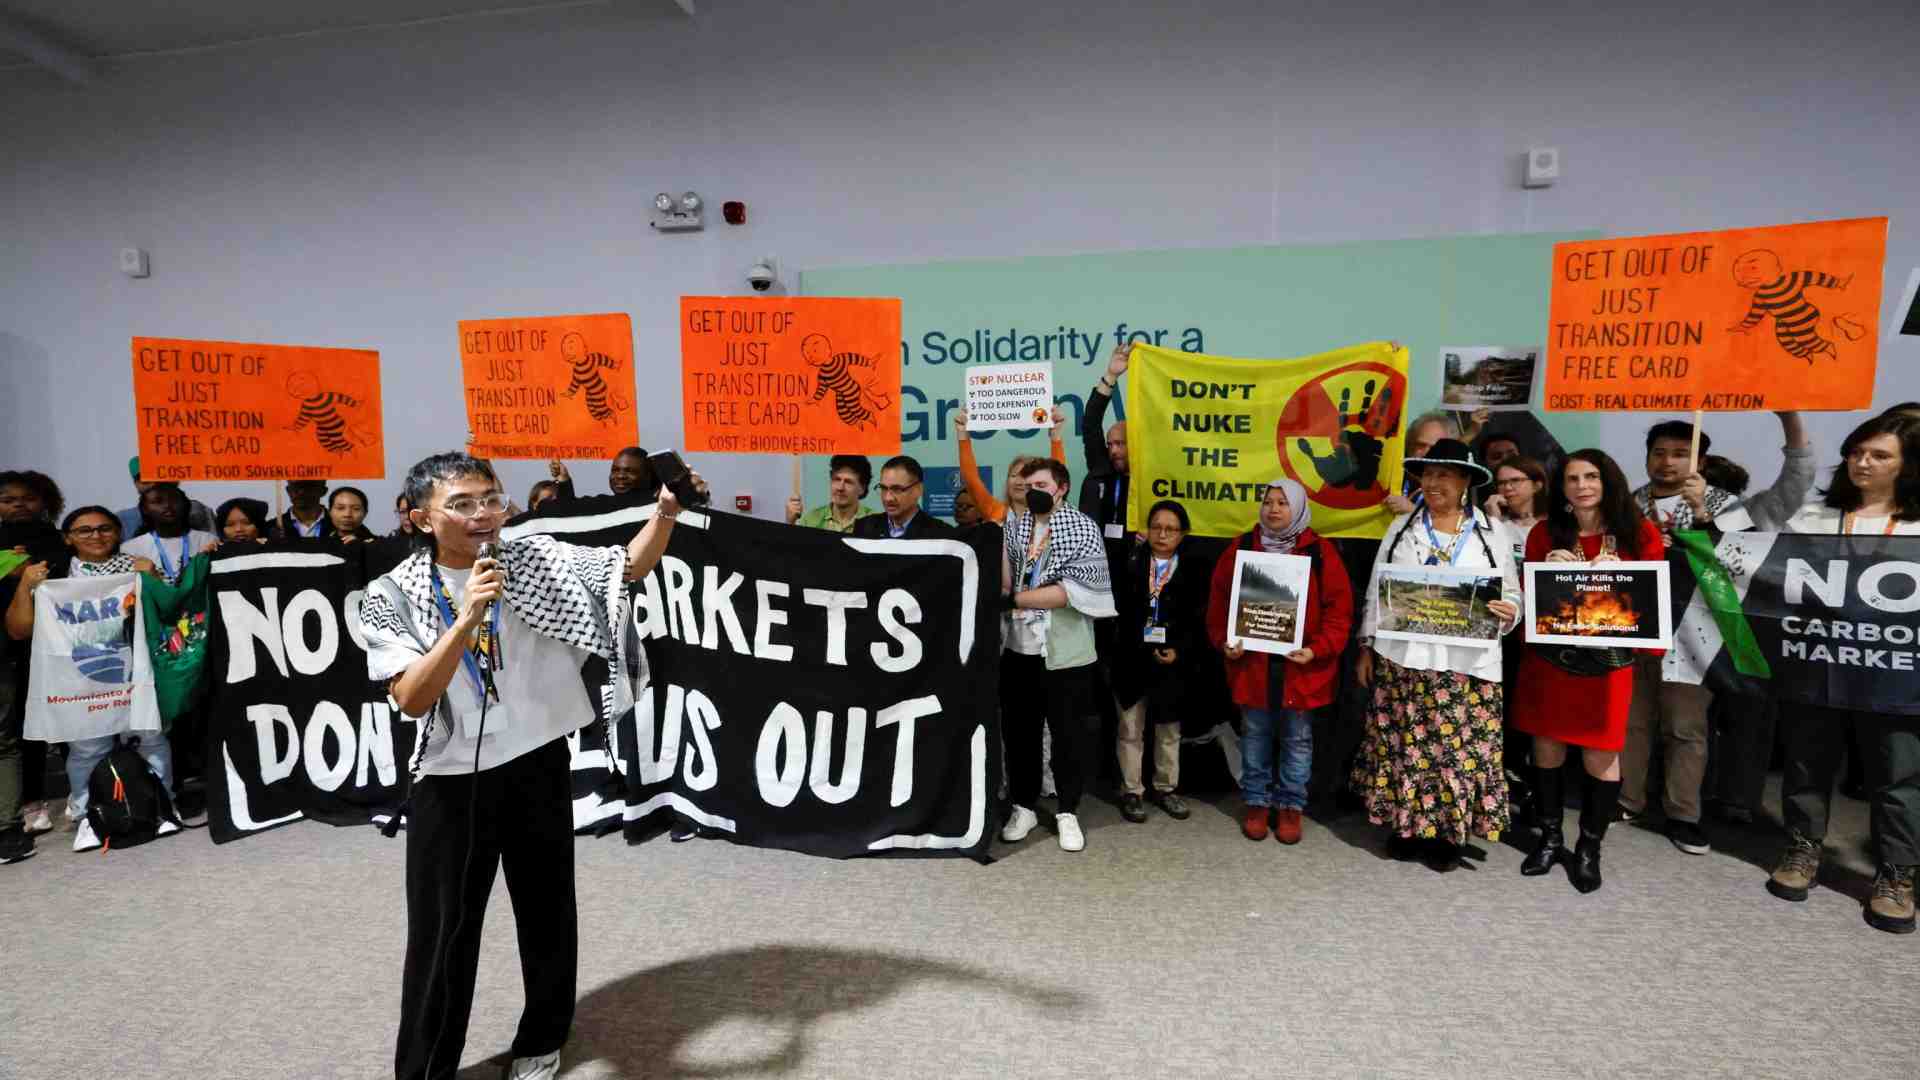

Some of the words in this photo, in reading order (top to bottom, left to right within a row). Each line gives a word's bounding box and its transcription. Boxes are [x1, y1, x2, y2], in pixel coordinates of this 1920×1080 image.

[1565, 250, 1616, 281] GET
[1624, 248, 1673, 278] OUT
[1681, 245, 1713, 274] OF
[1592, 287, 1661, 315] JUST
[690, 310, 724, 333] GET
[731, 311, 766, 333] OUT
[772, 311, 795, 333] OF
[464, 331, 491, 353] GET
[497, 331, 527, 352] OUT
[531, 330, 548, 351] OF
[922, 326, 1102, 366] Solidarity
[1114, 323, 1168, 347] for
[1181, 327, 1203, 353] a
[1556, 321, 1703, 348] TRANSITION
[140, 347, 183, 372] GET
[191, 351, 234, 375] OUT
[241, 355, 267, 377] OF
[720, 342, 768, 366] JUST
[487, 360, 524, 381] JUST
[997, 372, 1045, 384] NUCLEAR
[1563, 355, 1619, 380] FREE
[1629, 355, 1689, 379] CARD
[168, 382, 220, 403] JUST
[693, 372, 808, 397] TRANSITION
[977, 390, 994, 398] TOO
[996, 387, 1046, 397] DANGEROUS
[1171, 379, 1256, 400] DON'T
[467, 387, 556, 408] TRANSITION
[997, 400, 1039, 409] EXPENSIVE
[1595, 394, 1628, 409] REAL
[1632, 394, 1691, 409] CLIMATE
[1701, 393, 1765, 409] ACTION
[143, 407, 264, 430] TRANSITION
[475, 414, 509, 433] FREE
[514, 415, 550, 434] CARD
[694, 402, 739, 425] FREE
[748, 402, 799, 425] CARD
[901, 385, 1084, 441] Grn
[980, 413, 996, 421] TOO
[998, 412, 1020, 420] SLOW
[1173, 414, 1251, 433] NUKE
[155, 435, 201, 455] FREE
[211, 436, 260, 455] CARD
[750, 436, 835, 454] BIODIVERSITY
[1183, 446, 1239, 467] THE
[205, 466, 240, 478] FOOD
[1152, 479, 1267, 502] CLIMATE
[1556, 574, 1573, 582] Hot
[1575, 574, 1589, 582] Air
[1592, 574, 1613, 582] Kills
[1616, 574, 1633, 582] the
[1576, 584, 1611, 592] Planet!
[1784, 558, 1920, 613] NO
[633, 555, 923, 673] ARKETS
[217, 587, 339, 684] NO
[1781, 616, 1920, 646] CARBO
[1781, 640, 1920, 671] MARKE
[48, 686, 124, 704] Movimiento
[88, 704, 109, 712] por
[634, 684, 721, 791] US
[756, 695, 943, 808] OUT
